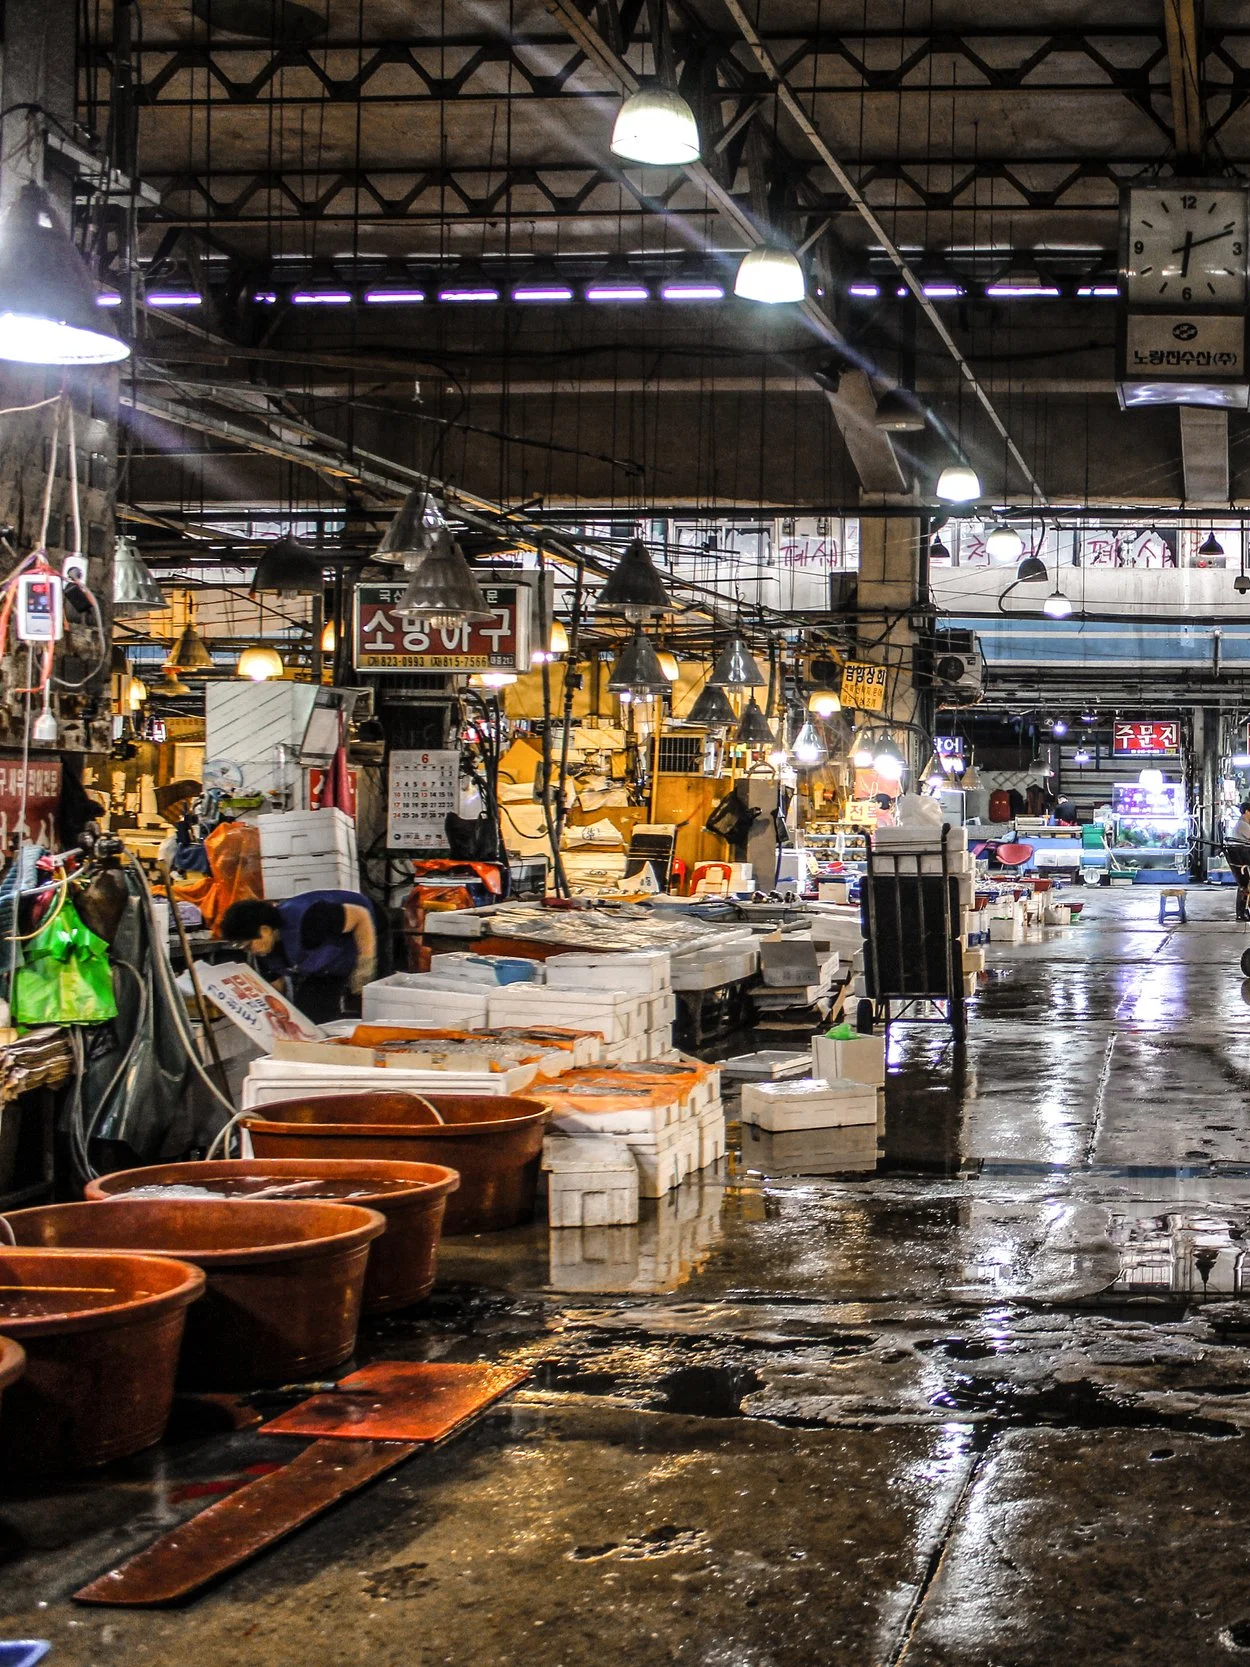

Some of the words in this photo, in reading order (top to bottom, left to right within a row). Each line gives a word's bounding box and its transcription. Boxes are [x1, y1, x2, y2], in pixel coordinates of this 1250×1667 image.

[1180, 196, 1197, 209] 12
[1134, 241, 1144, 254] 9
[1232, 242, 1242, 255] 3
[1182, 287, 1192, 300] 6
[1115, 723, 1178, 749] 주문진
[421, 753, 429, 763] 6
